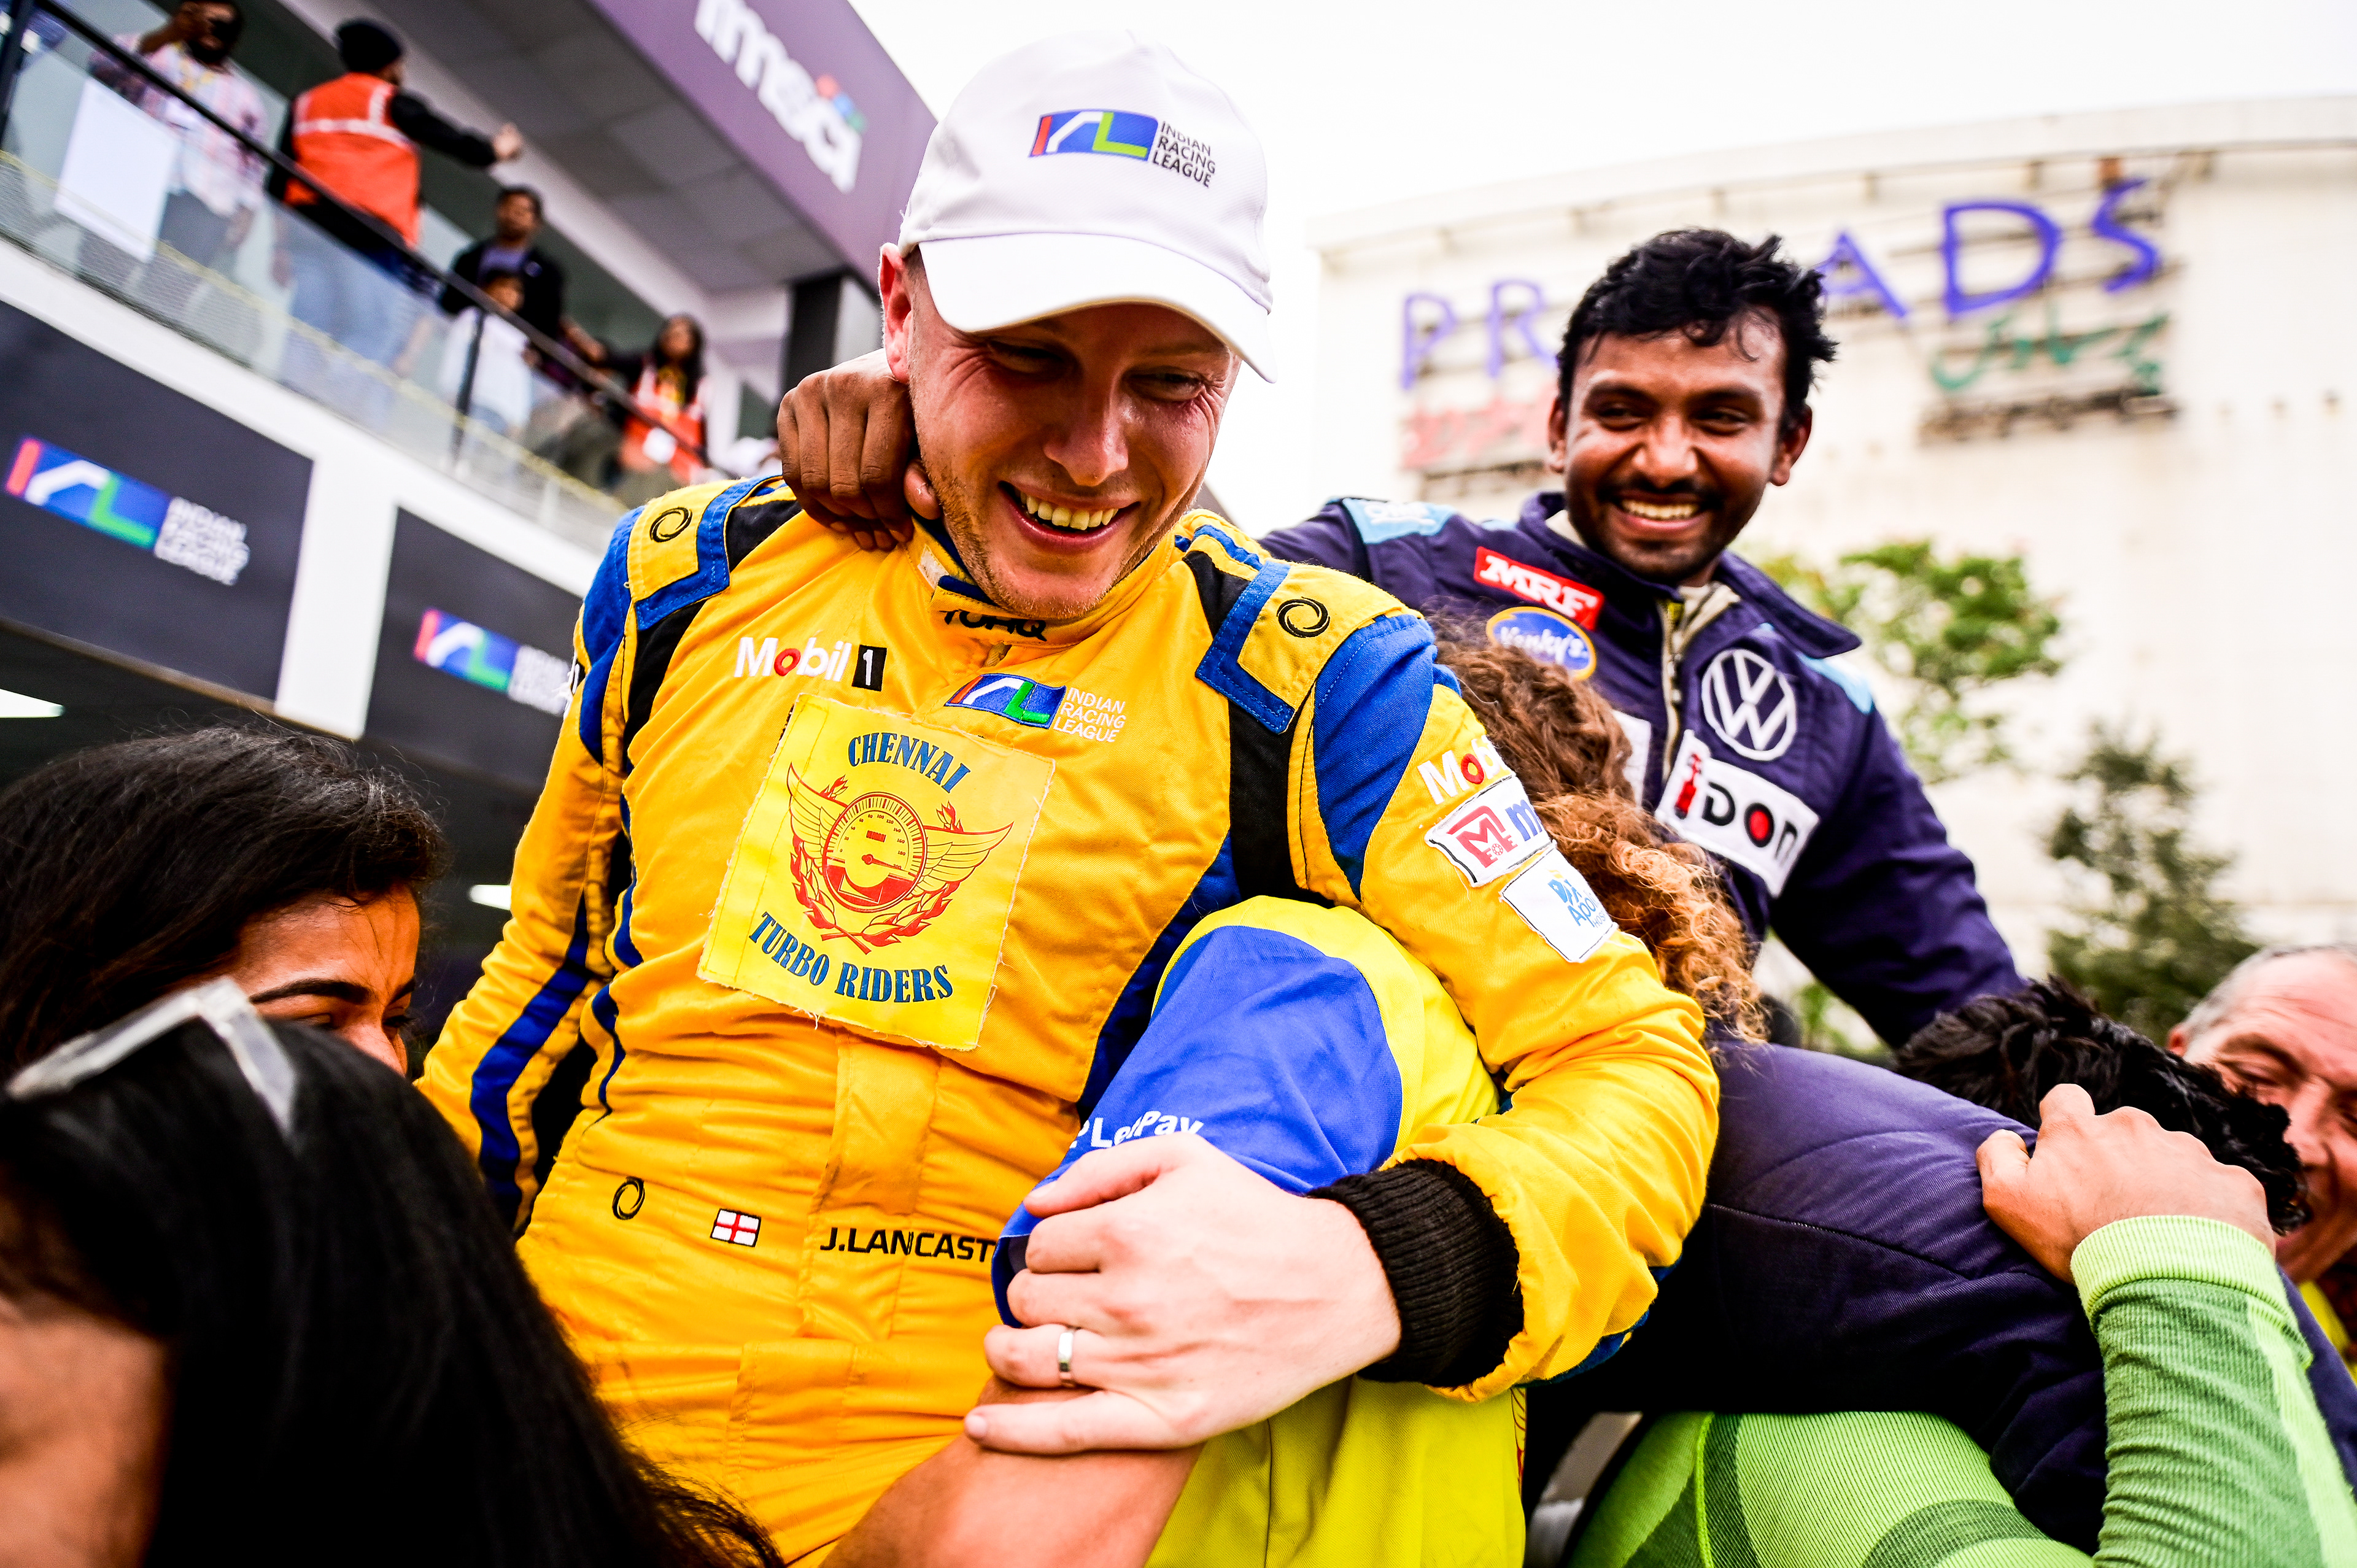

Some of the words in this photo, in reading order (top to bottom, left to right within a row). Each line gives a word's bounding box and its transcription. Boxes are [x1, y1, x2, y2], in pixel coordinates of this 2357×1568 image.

[1158, 135, 1215, 174] RACING
[1161, 121, 1210, 156] INDIAN
[1153, 150, 1211, 188] LEAGUE
[1479, 555, 1597, 618] MRF
[734, 636, 852, 682] Mobil
[1061, 701, 1126, 729] RACING
[1066, 687, 1126, 714] INDIAN
[1053, 716, 1120, 743] LEAGUE
[848, 732, 971, 794] CHENNAI
[749, 911, 829, 986] TURBO
[834, 965, 953, 1003] RIDERS
[820, 1227, 997, 1262] J.LANCAST
